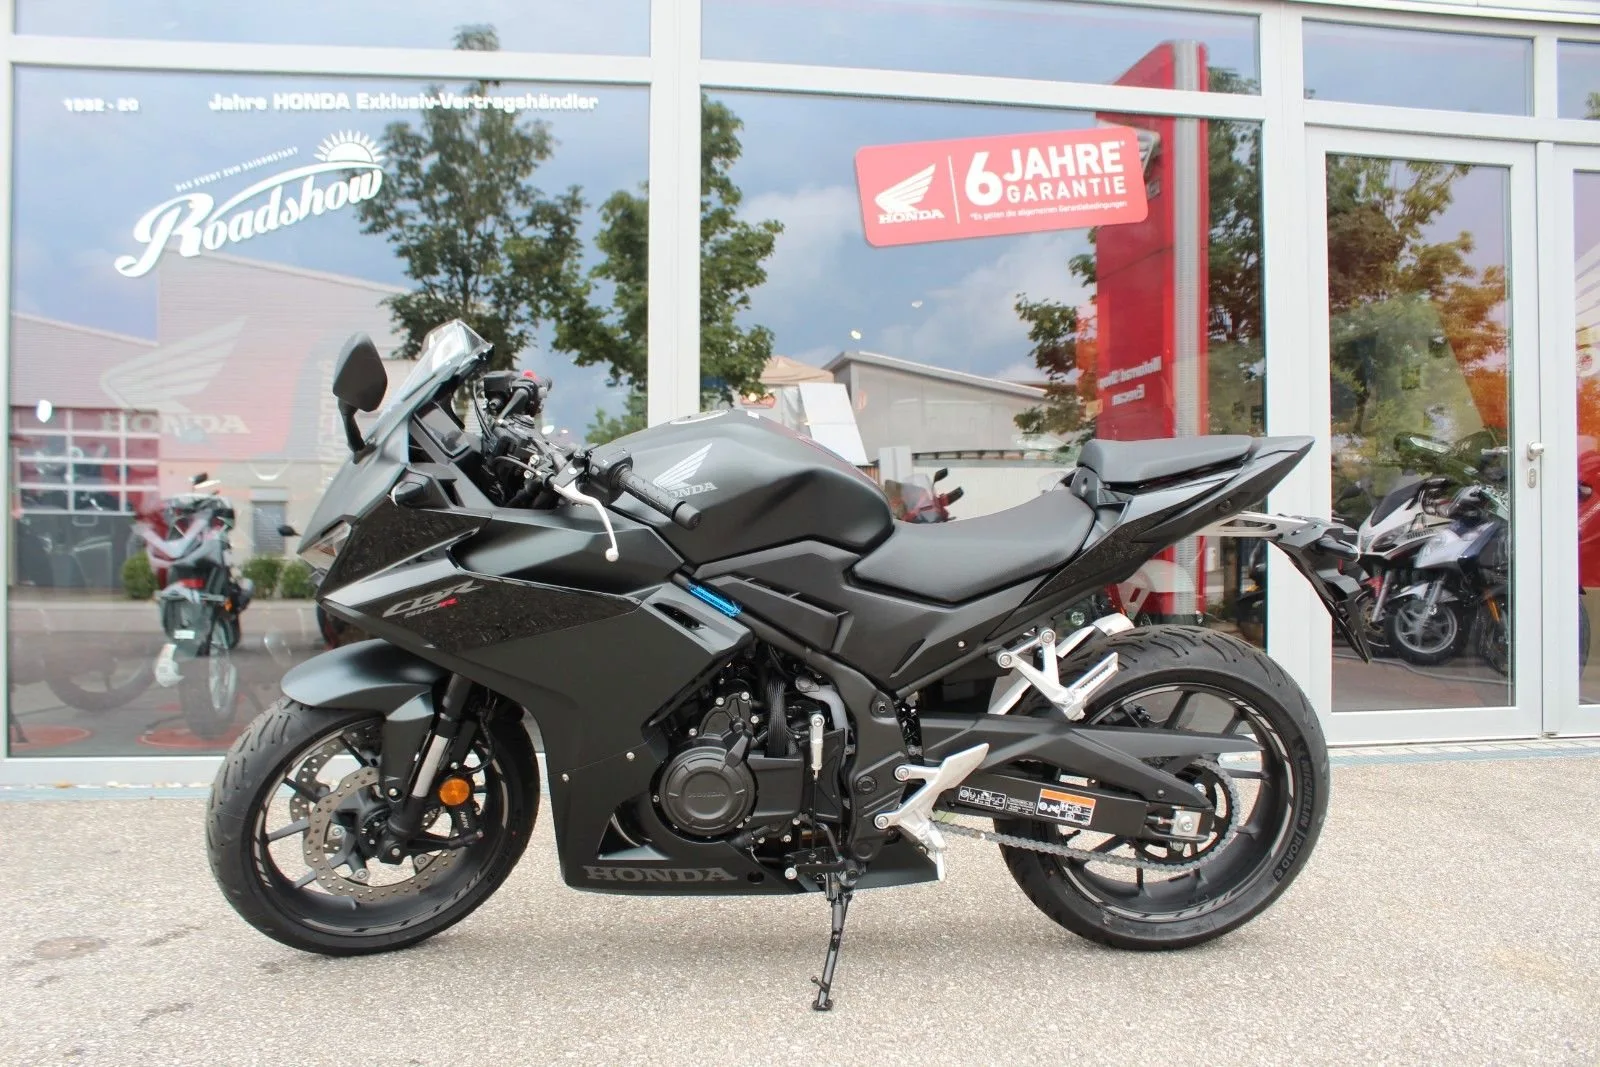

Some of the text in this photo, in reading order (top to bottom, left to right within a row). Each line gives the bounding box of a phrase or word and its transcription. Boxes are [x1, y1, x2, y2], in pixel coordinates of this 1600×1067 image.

[208, 93, 267, 111] Jahre
[272, 92, 351, 110] HONDA
[964, 150, 1003, 207] 6
[1006, 175, 1127, 204] GARANTIE
[113, 168, 383, 277] Roadshow
[878, 207, 946, 225] HONDA
[1299, 759, 1314, 828] MICHELIN
[1281, 835, 1304, 870] ROAD
[581, 865, 739, 882] HONDA
